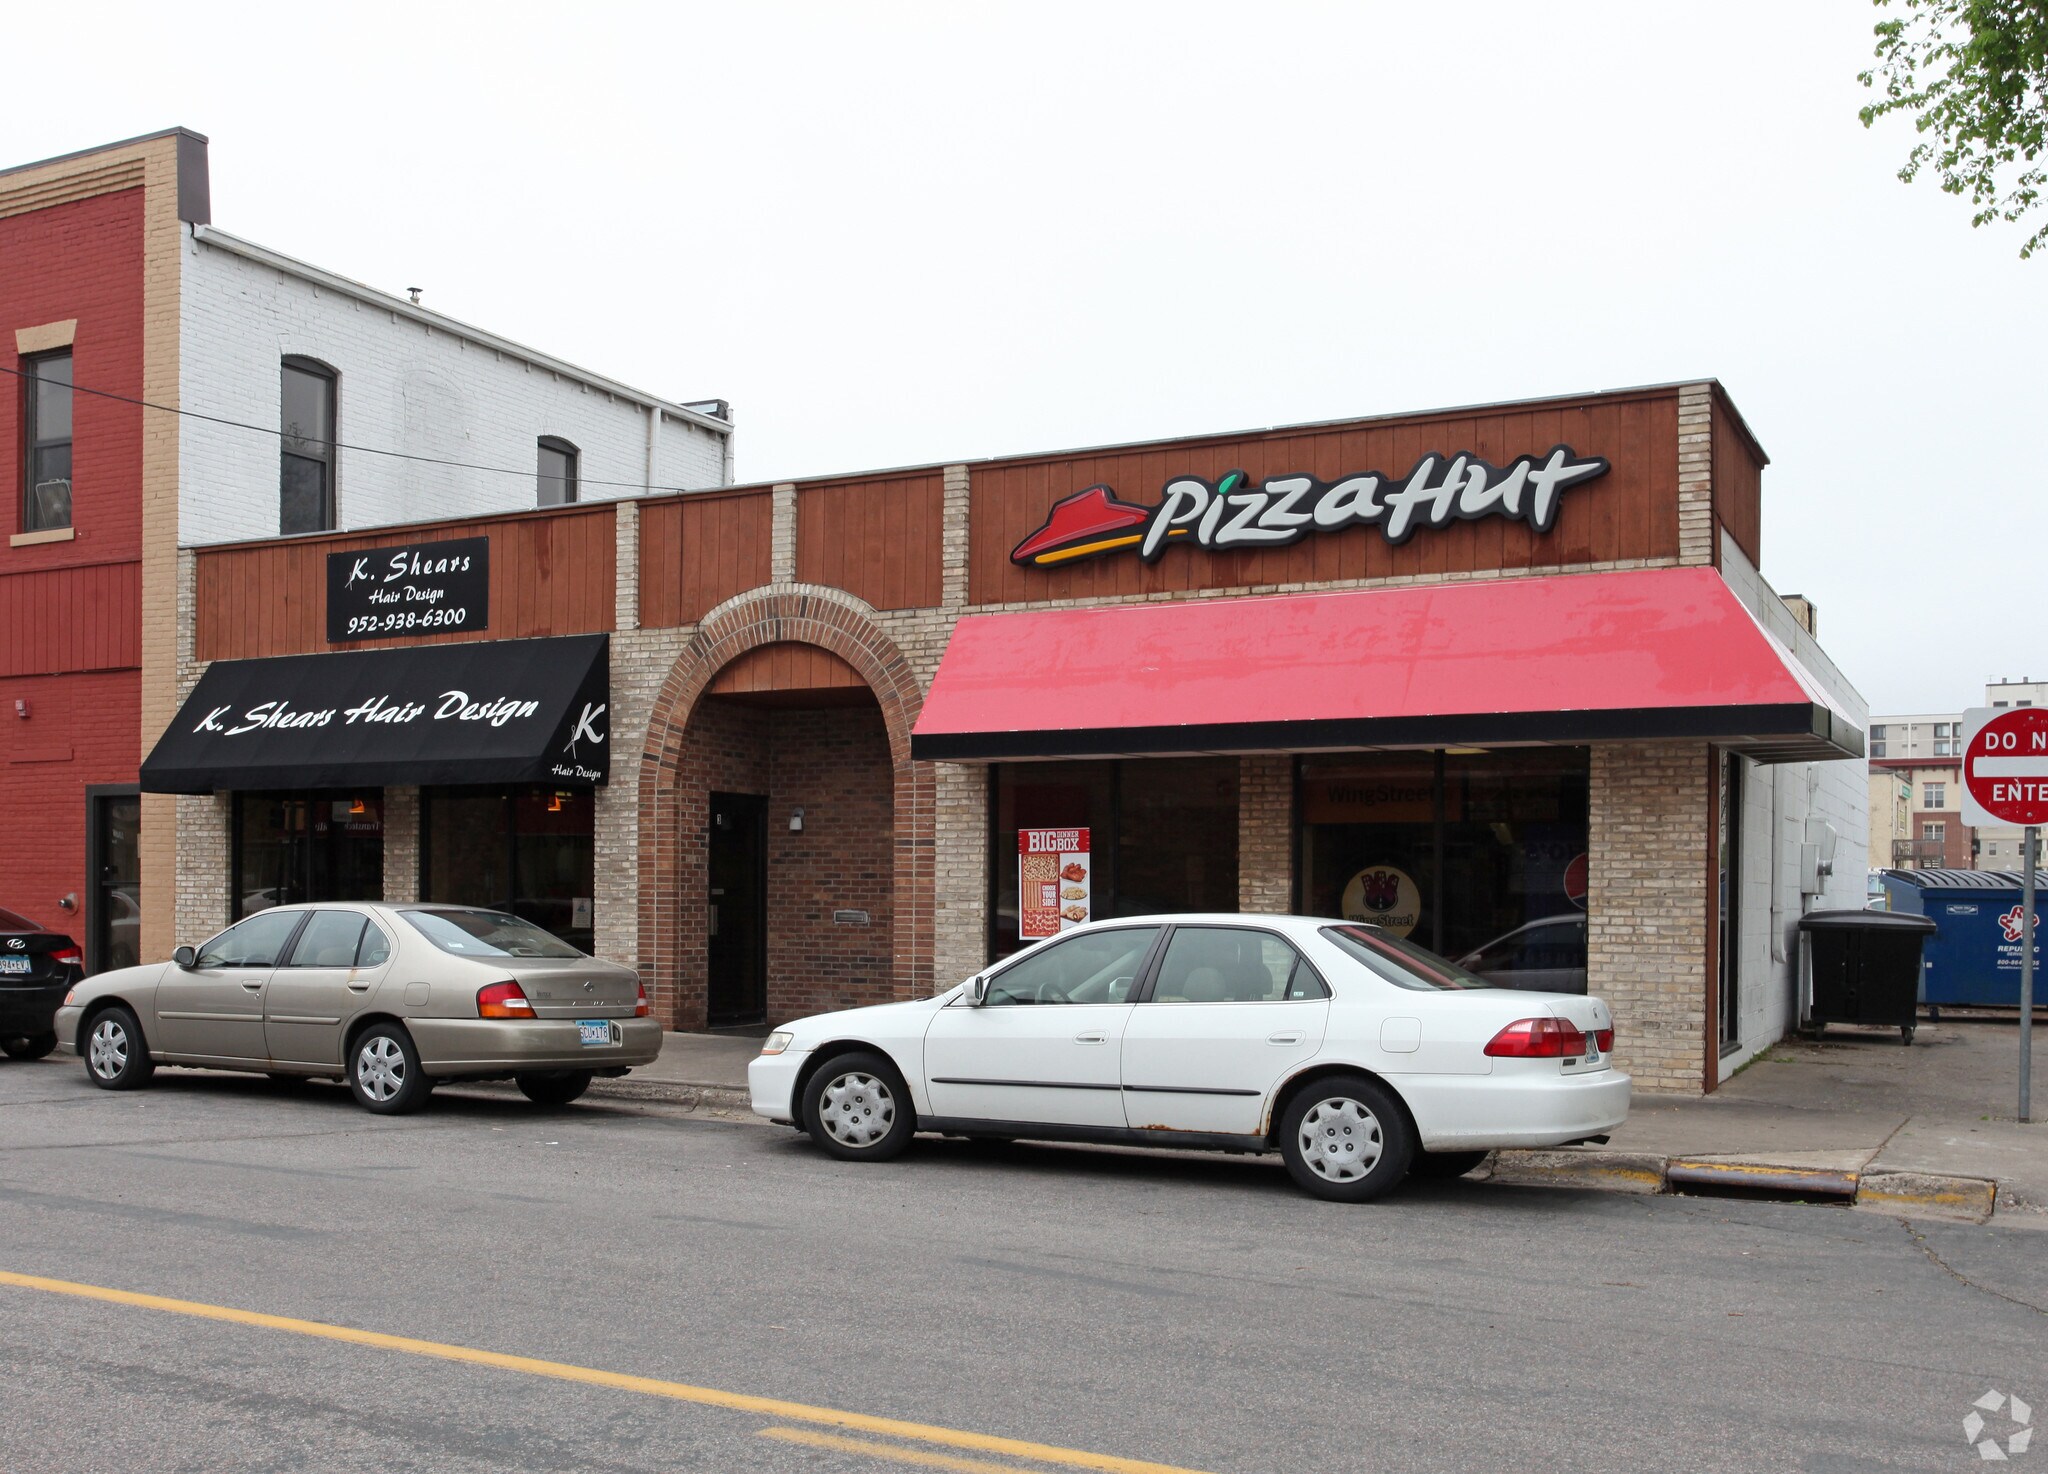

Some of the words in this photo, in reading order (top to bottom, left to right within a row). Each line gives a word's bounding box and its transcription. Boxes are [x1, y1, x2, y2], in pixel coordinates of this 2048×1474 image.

[1384, 449, 1601, 539] Hut
[349, 557, 375, 581] K.
[384, 551, 470, 582] Shears
[369, 589, 400, 605] Hair
[403, 585, 444, 608] Design
[347, 607, 466, 635] 952-938-6300
[193, 705, 231, 733] K.
[224, 701, 336, 736] Shears
[344, 695, 425, 725] Hair
[433, 690, 539, 727] Design
[573, 702, 606, 744] K
[1985, 732, 2017, 750] DO
[552, 764, 573, 776] Hair
[575, 765, 601, 779] Design
[1993, 783, 2048, 801] ENTE
[1029, 831, 1056, 852] BIG
[1057, 838, 1079, 851] BOX
[1042, 898, 1056, 907] SIDE!
[1997, 945, 2040, 953] REPUC
